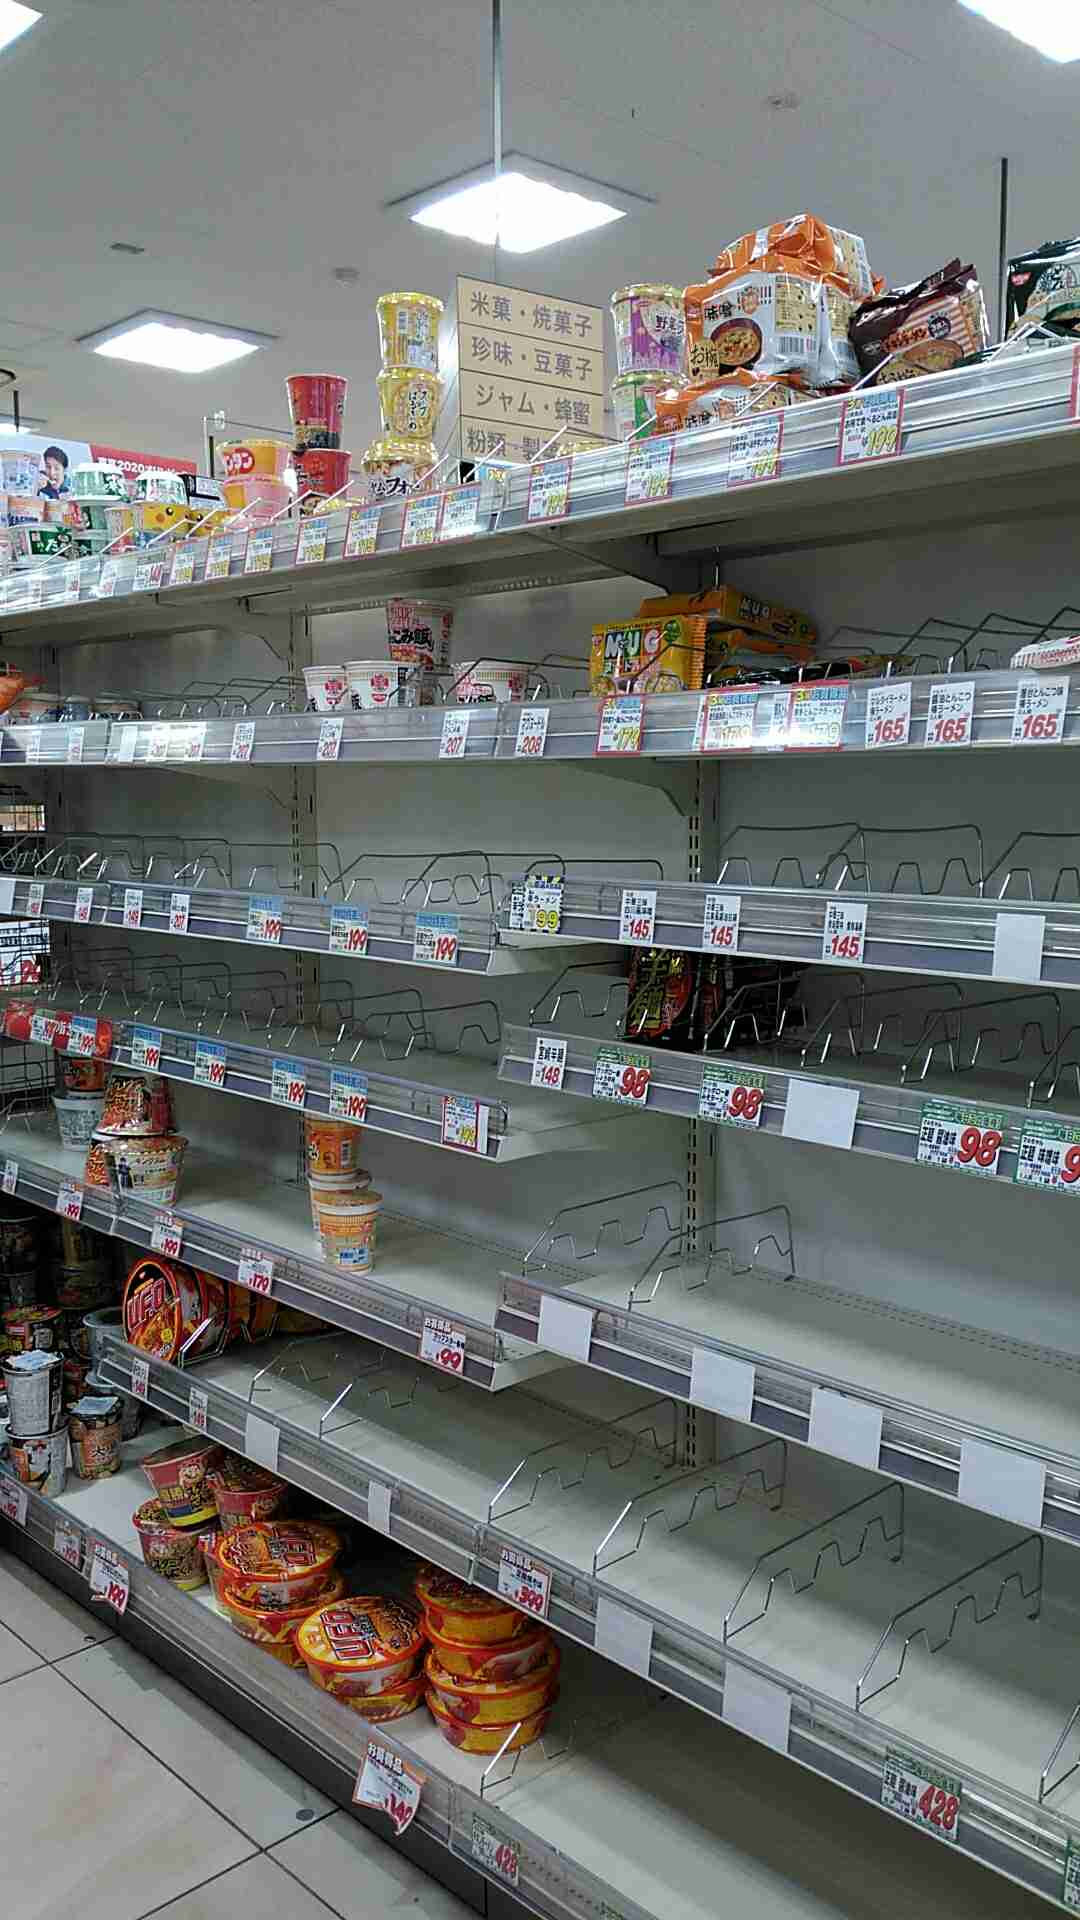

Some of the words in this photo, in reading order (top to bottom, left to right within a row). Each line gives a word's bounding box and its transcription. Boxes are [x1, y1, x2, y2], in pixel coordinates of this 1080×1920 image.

[470, 291, 592, 338] 米菓・焼菓子
[471, 336, 592, 381] 珍味・豆菓子
[476, 384, 590, 426] ジャム・蜂蜜
[603, 631, 660, 659] MUG
[874, 717, 905, 743] 165
[934, 717, 967, 743] 165
[1022, 714, 1057, 739] 165
[348, 928, 368, 951] 199
[628, 919, 650, 938] 145
[710, 926, 734, 946] 145
[435, 936, 457, 961] 199
[830, 935, 860, 959] 145
[287, 1080, 306, 1104] 199
[619, 1065, 650, 1099] 98
[727, 1085, 764, 1120] 98
[957, 1126, 1003, 1167] 98
[252, 1273, 269, 1292] 179
[441, 1348, 462, 1369] 99
[918, 1784, 960, 1831] 428
